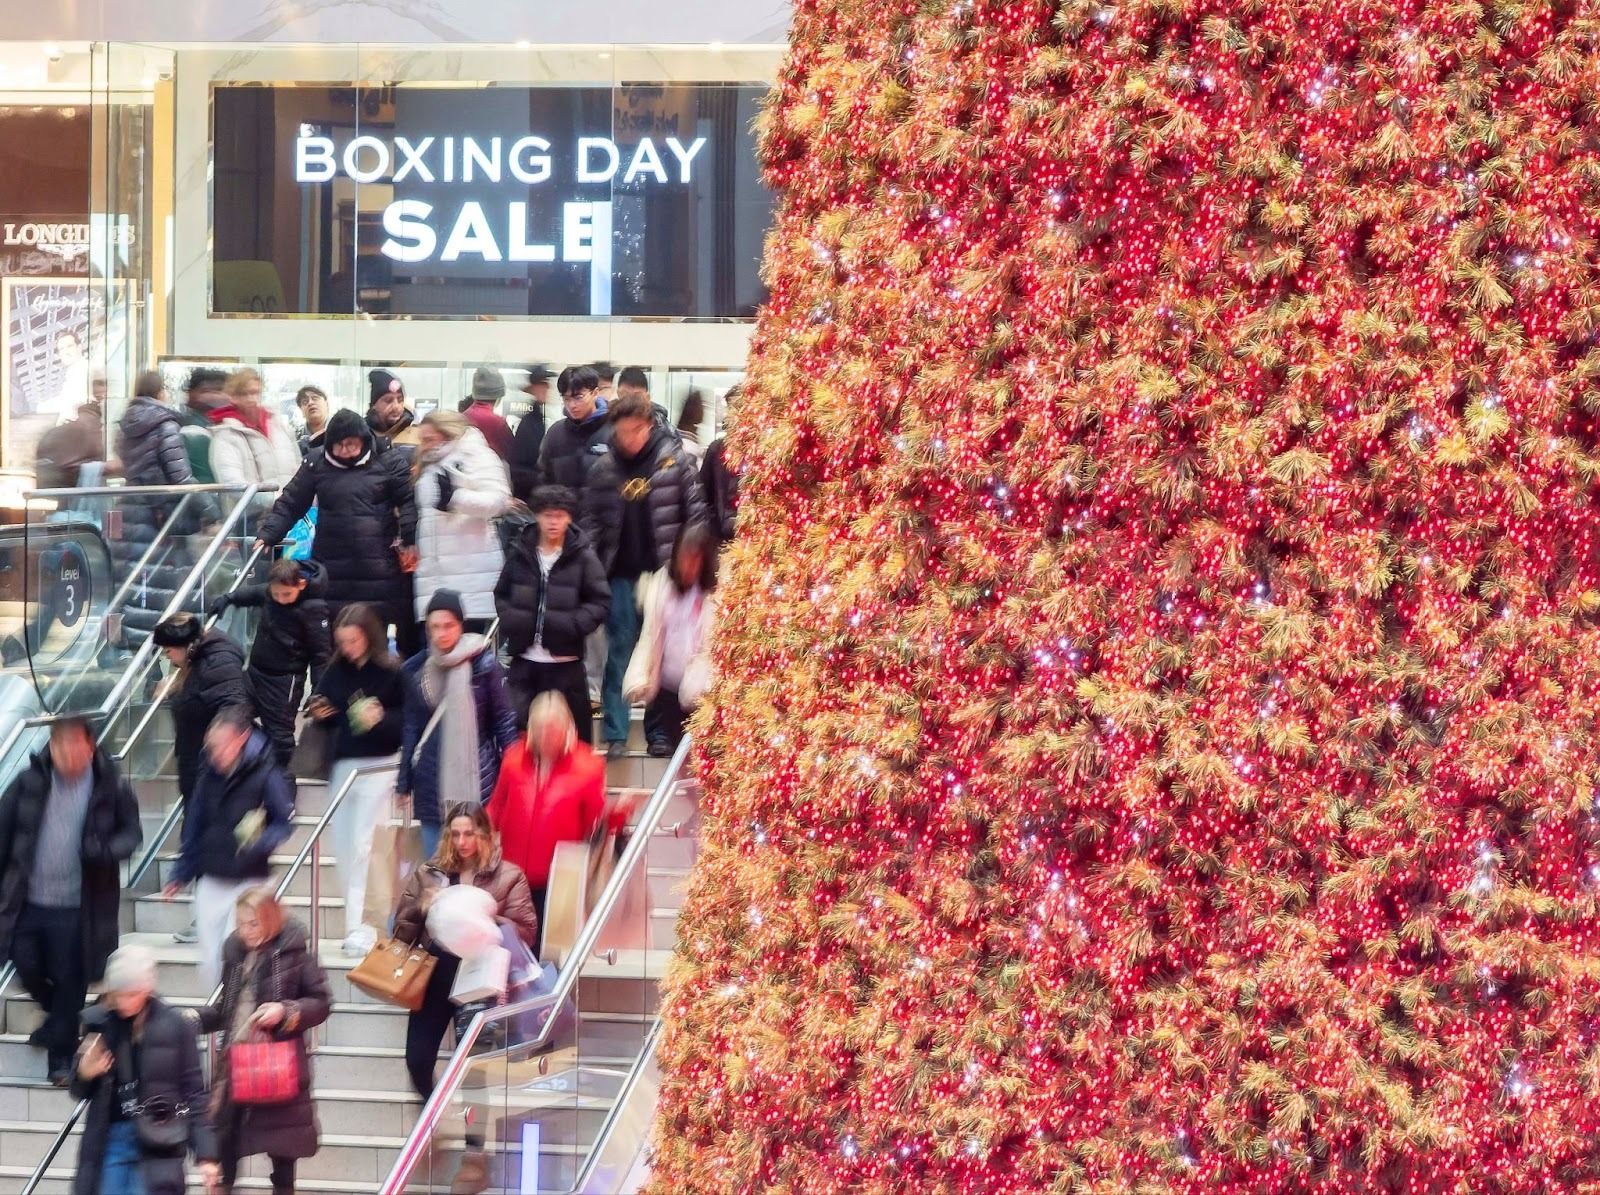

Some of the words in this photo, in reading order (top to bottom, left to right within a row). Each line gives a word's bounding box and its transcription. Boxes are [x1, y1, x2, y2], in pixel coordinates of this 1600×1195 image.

[295, 135, 552, 184] BOXING
[576, 137, 707, 184] DAY
[4, 223, 136, 246] LONGIS
[380, 199, 596, 262] SALE
[60, 564, 80, 581] Level
[65, 584, 75, 616] 3
